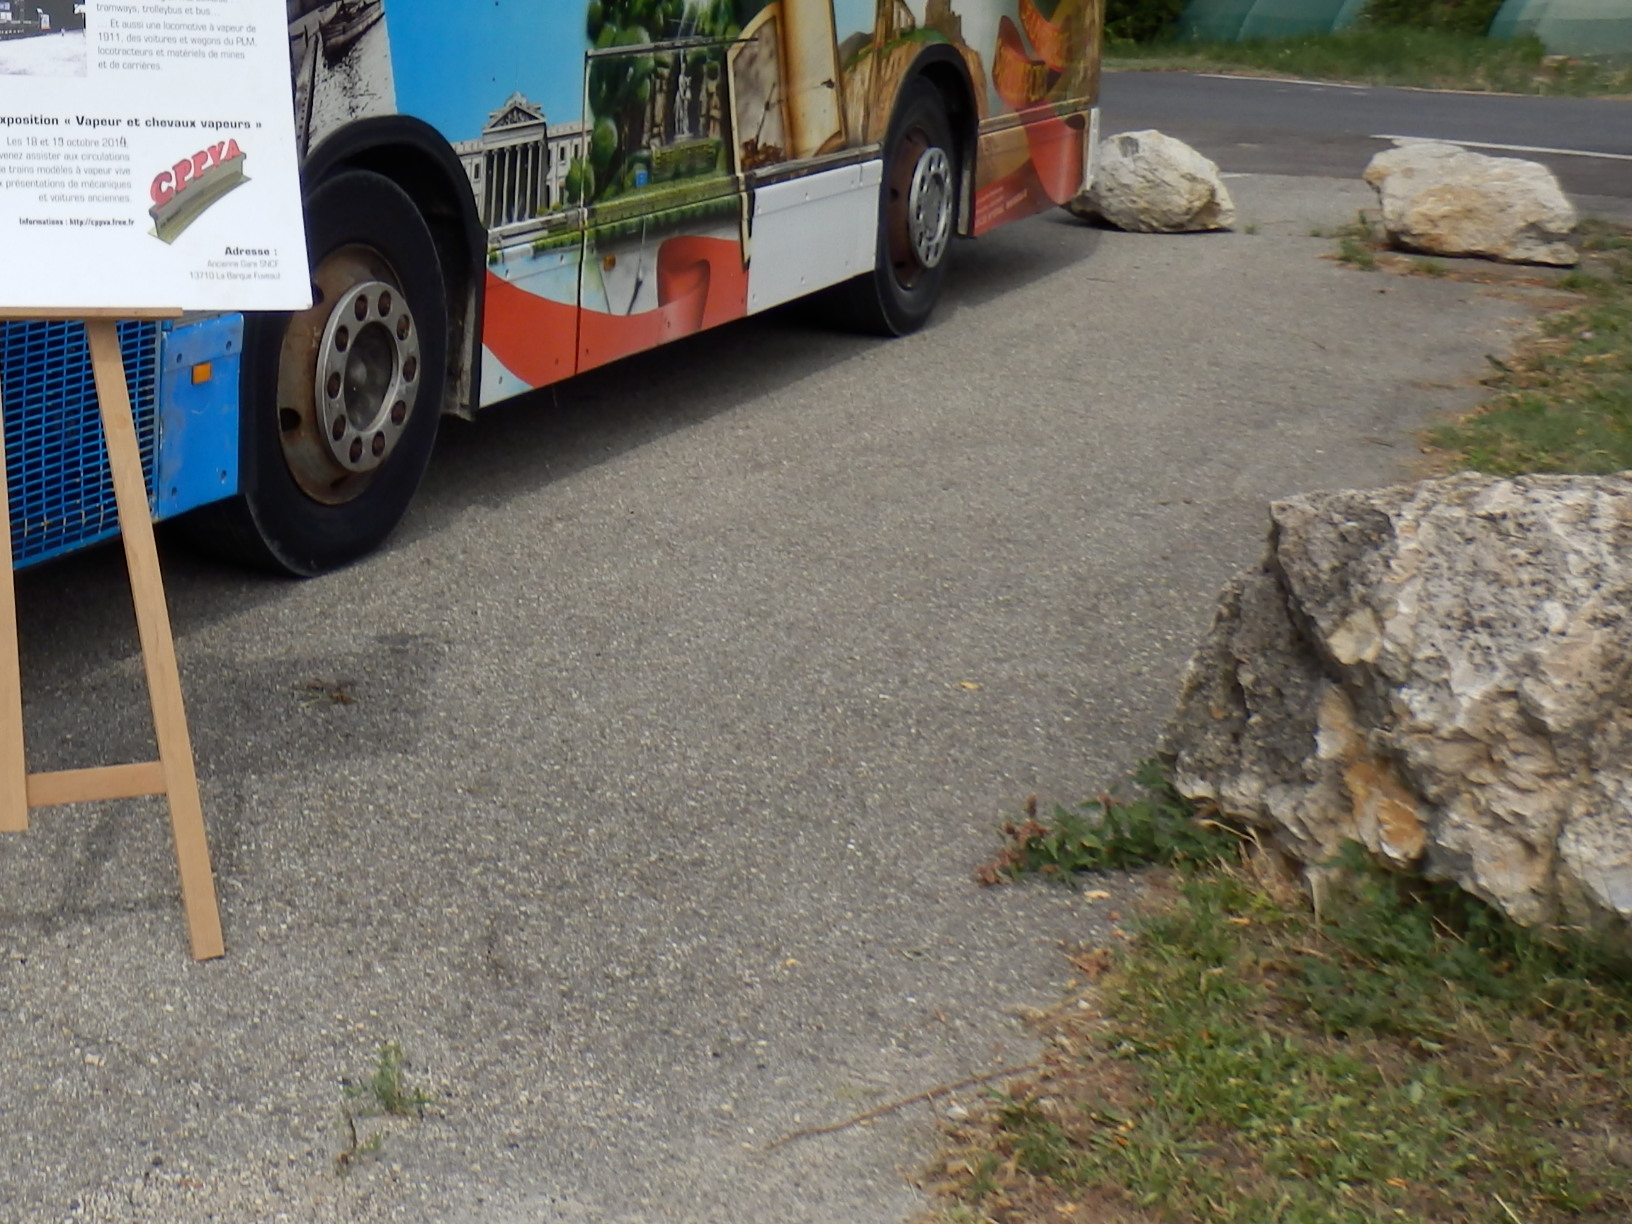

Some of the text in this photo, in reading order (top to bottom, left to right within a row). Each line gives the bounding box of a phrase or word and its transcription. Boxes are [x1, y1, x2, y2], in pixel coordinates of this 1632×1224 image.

[96, 3, 140, 14] tramways,
[142, 4, 182, 16] trolleybus
[184, 6, 193, 15] et
[110, 19, 119, 29] Et
[121, 19, 143, 30] aussi
[146, 21, 161, 30] une
[163, 21, 207, 32] locomotive
[209, 22, 215, 32] à
[216, 24, 246, 35] vapeur
[248, 23, 256, 33] de
[126, 34, 141, 43] des
[143, 34, 177, 44] voitures
[179, 35, 188, 45] et
[190, 37, 221, 48] wagons
[223, 36, 234, 46] du
[98, 46, 245, 60] locotracteurs et matériels de mines
[98, 60, 107, 69] et
[109, 60, 120, 70] de
[75, 115, 122, 128] Vapeur
[126, 117, 140, 127] et
[145, 117, 196, 128] chevaux
[200, 120, 251, 130] vapeurs
[6, 136, 23, 146] Les
[26, 136, 37, 146] 18
[40, 137, 49, 147] et
[66, 137, 99, 147] octobre
[26, 151, 61, 161] assister
[64, 153, 78, 161] aux
[81, 151, 130, 162] circulations
[8, 164, 34, 174] trains
[36, 164, 73, 175] modèles
[75, 165, 81, 175] à
[83, 166, 112, 176] vapeur
[114, 166, 131, 175] vive
[150, 138, 242, 207] CPPVA
[5, 178, 65, 189] présentations
[68, 179, 79, 189] de
[81, 179, 132, 190] mécaniques
[38, 192, 48, 202] et
[50, 192, 85, 202] voitures
[19, 217, 64, 226] Informations
[224, 246, 270, 256] Adresse
